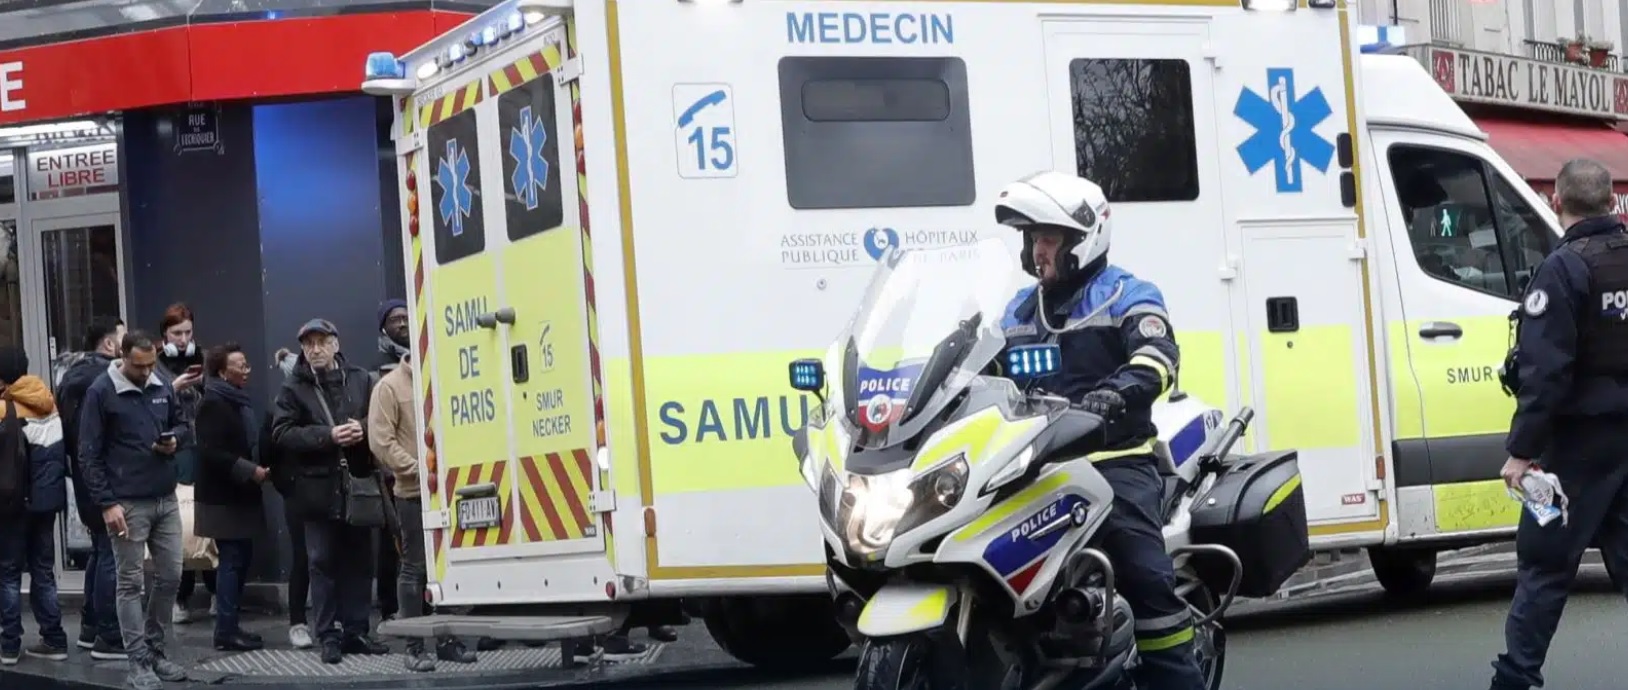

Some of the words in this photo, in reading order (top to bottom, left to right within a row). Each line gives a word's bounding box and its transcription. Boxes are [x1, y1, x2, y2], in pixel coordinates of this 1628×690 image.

[786, 12, 953, 43] MEDECIN
[1458, 54, 1519, 101] TABAC
[1528, 63, 1549, 104] LE
[1554, 67, 1611, 112] MAYOL
[189, 113, 206, 126] RUE
[36, 149, 116, 172] ENTREE
[687, 126, 734, 171] 15
[48, 168, 105, 188] LIBRE
[780, 233, 858, 247] ASSISTANCE
[905, 230, 979, 244] HÔPITAUX
[781, 249, 859, 265] PUBLIQUE
[444, 295, 488, 337] SAMU
[459, 345, 480, 379] DE
[541, 343, 554, 369] 15
[860, 378, 911, 394] POLICE
[1446, 366, 1493, 384] SMUR
[450, 388, 495, 427] PARIS
[536, 389, 563, 411] SMUR
[532, 414, 572, 438] NECKER
[659, 394, 808, 445] SAMU
[1011, 502, 1057, 543] POLICE
